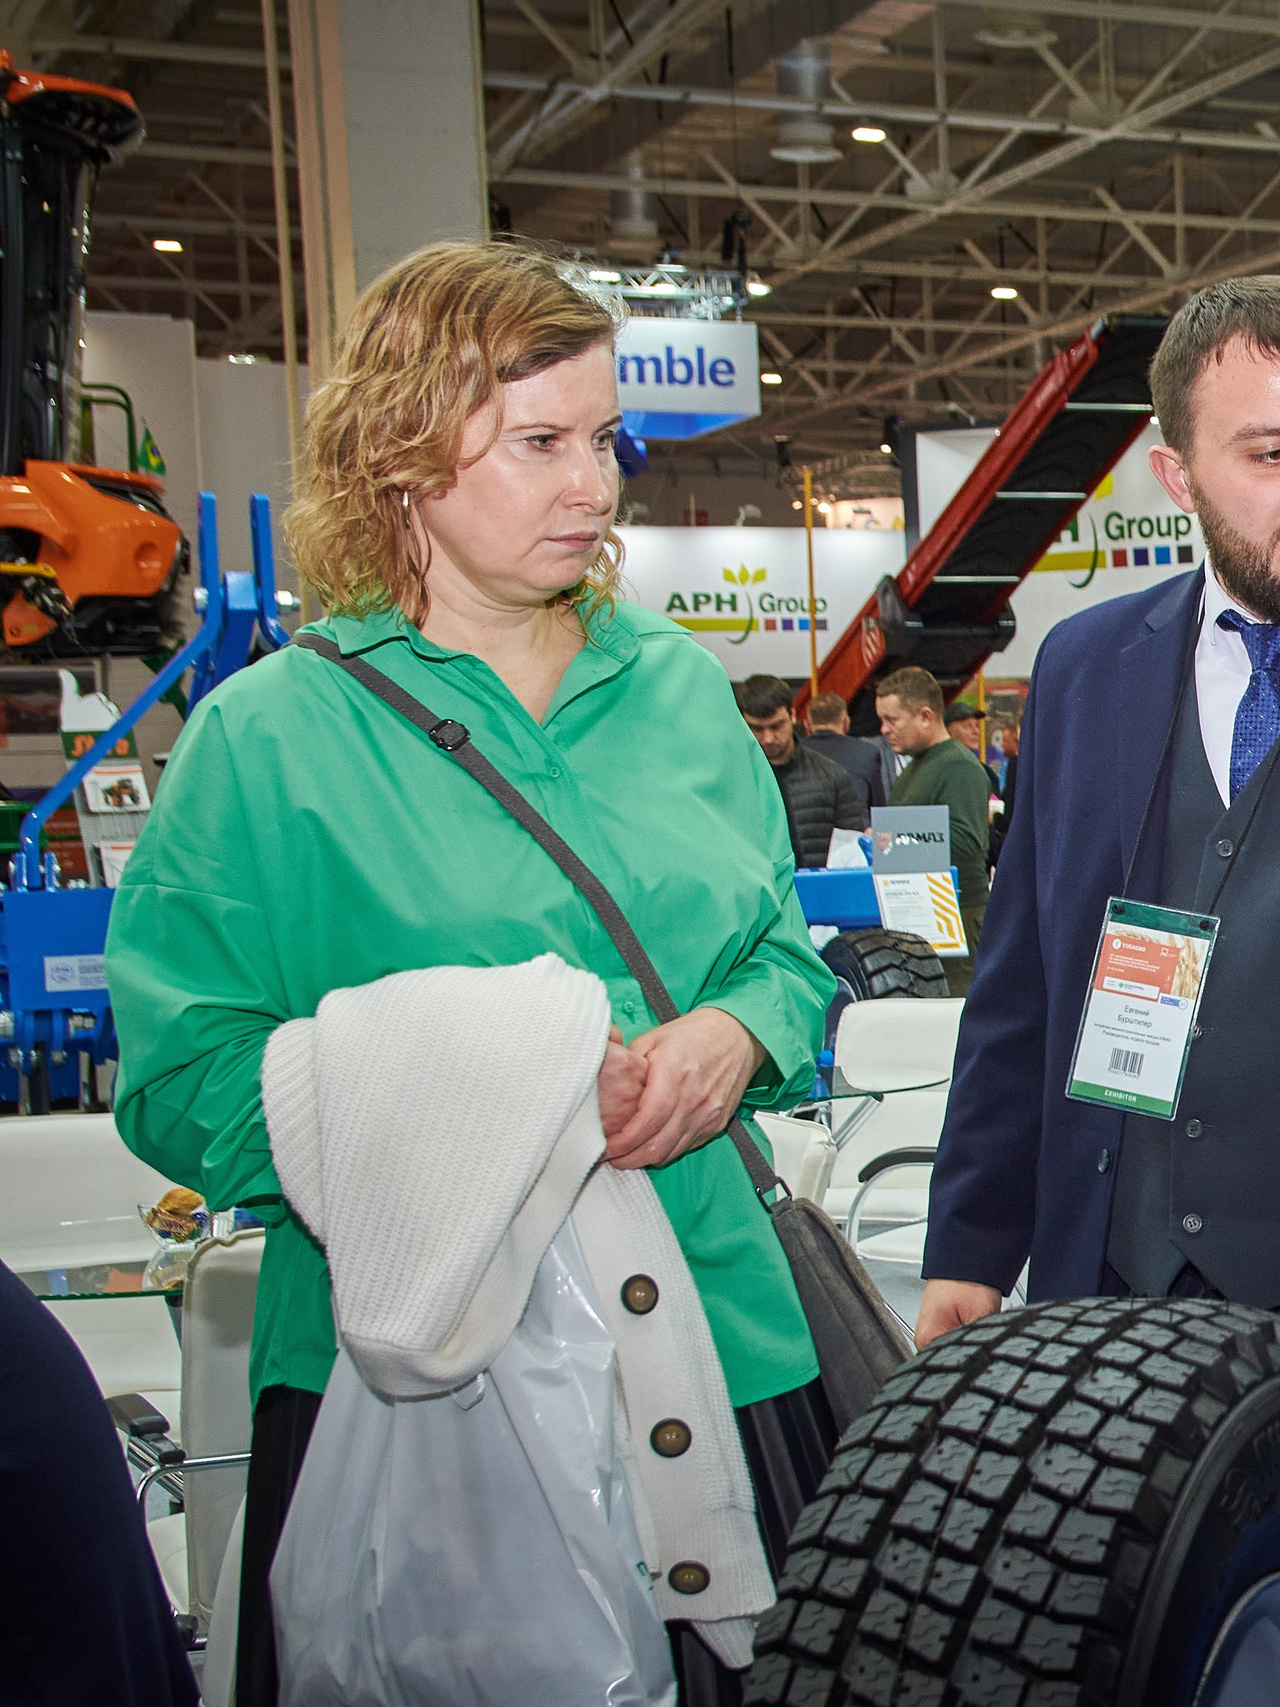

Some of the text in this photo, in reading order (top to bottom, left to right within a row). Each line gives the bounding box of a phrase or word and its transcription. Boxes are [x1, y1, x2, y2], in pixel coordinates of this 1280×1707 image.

[619, 346, 735, 386] mble
[1104, 510, 1192, 541] Group
[665, 592, 828, 615] APH Group
[1124, 1004, 1150, 1017] Евгений
[1103, 1089, 1138, 1102] EXHIBITOR
